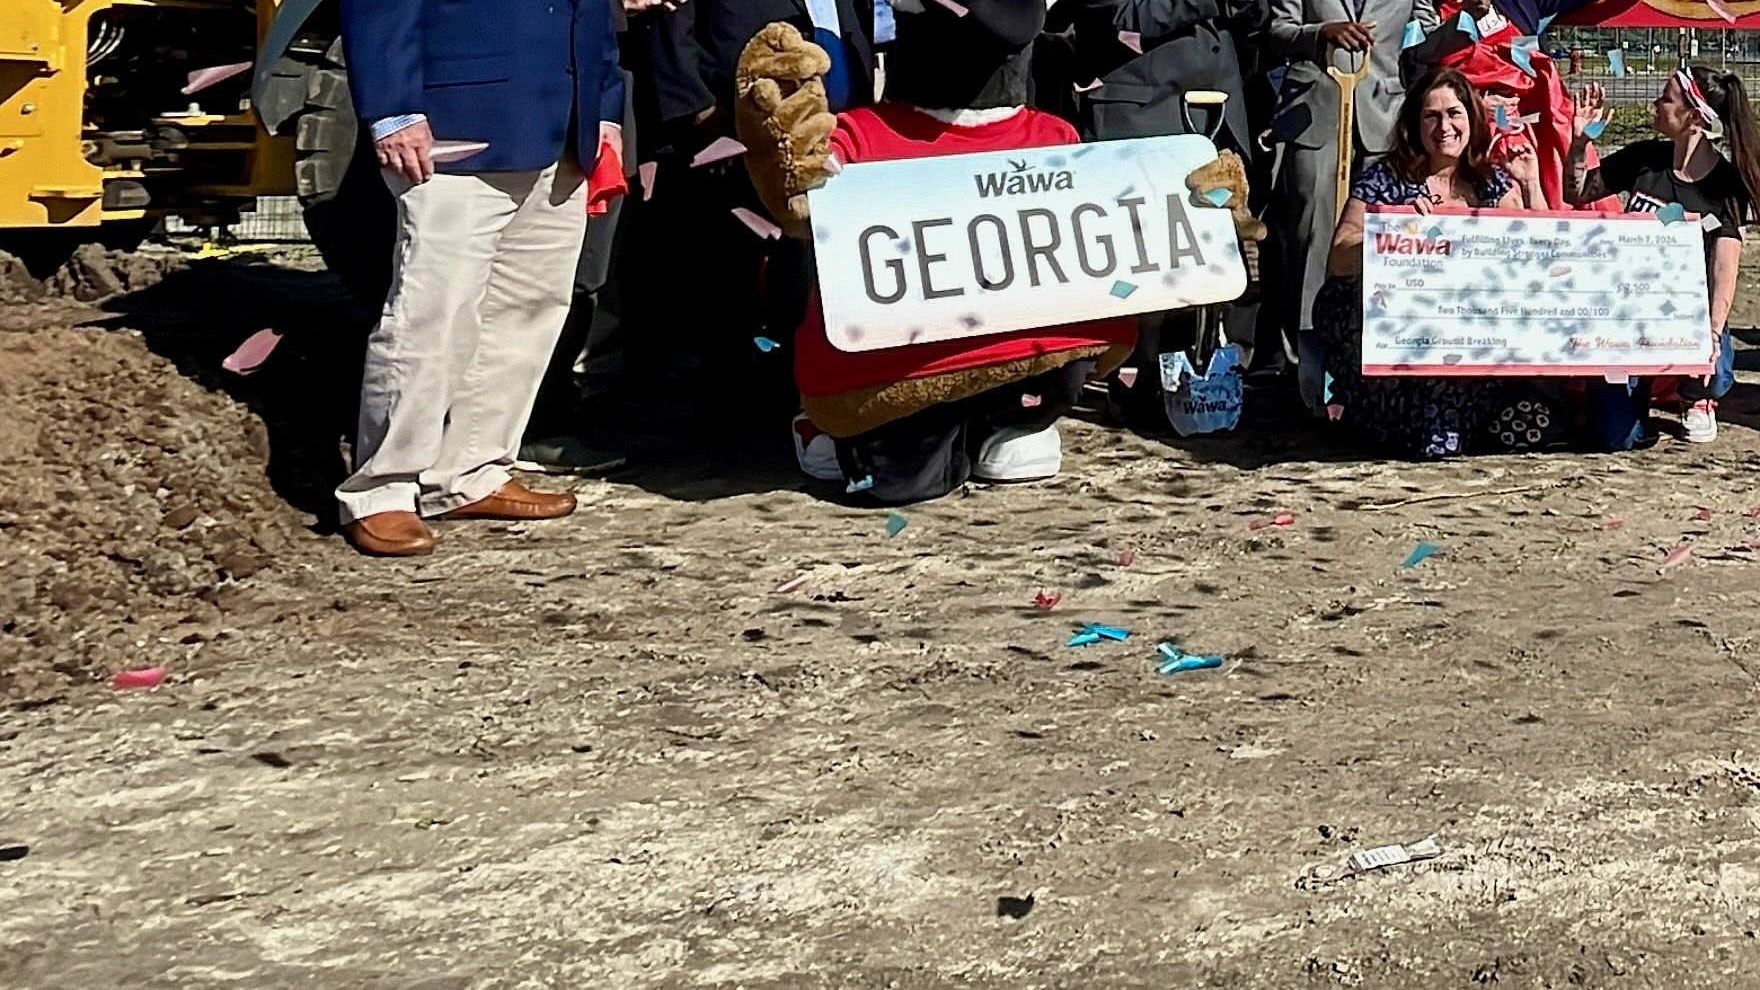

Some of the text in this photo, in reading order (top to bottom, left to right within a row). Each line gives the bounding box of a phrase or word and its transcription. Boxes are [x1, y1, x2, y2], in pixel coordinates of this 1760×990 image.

[974, 168, 1074, 198] Wawa
[1375, 232, 1451, 256] Wawa
[1618, 235, 1644, 244] March
[858, 193, 1206, 305] GEORGIA
[1462, 248, 1472, 258] by
[1474, 247, 1511, 259] Building
[1383, 257, 1444, 268] Foundation
[1457, 305, 1499, 315] Thousand
[1520, 306, 1558, 316] Hundred
[1560, 307, 1575, 316] and
[1577, 307, 1610, 317] 00/100
[1395, 335, 1431, 347] Georgia
[1432, 335, 1465, 346] Ground
[1467, 336, 1507, 348] Breaking
[1184, 400, 1227, 414] Wawa
